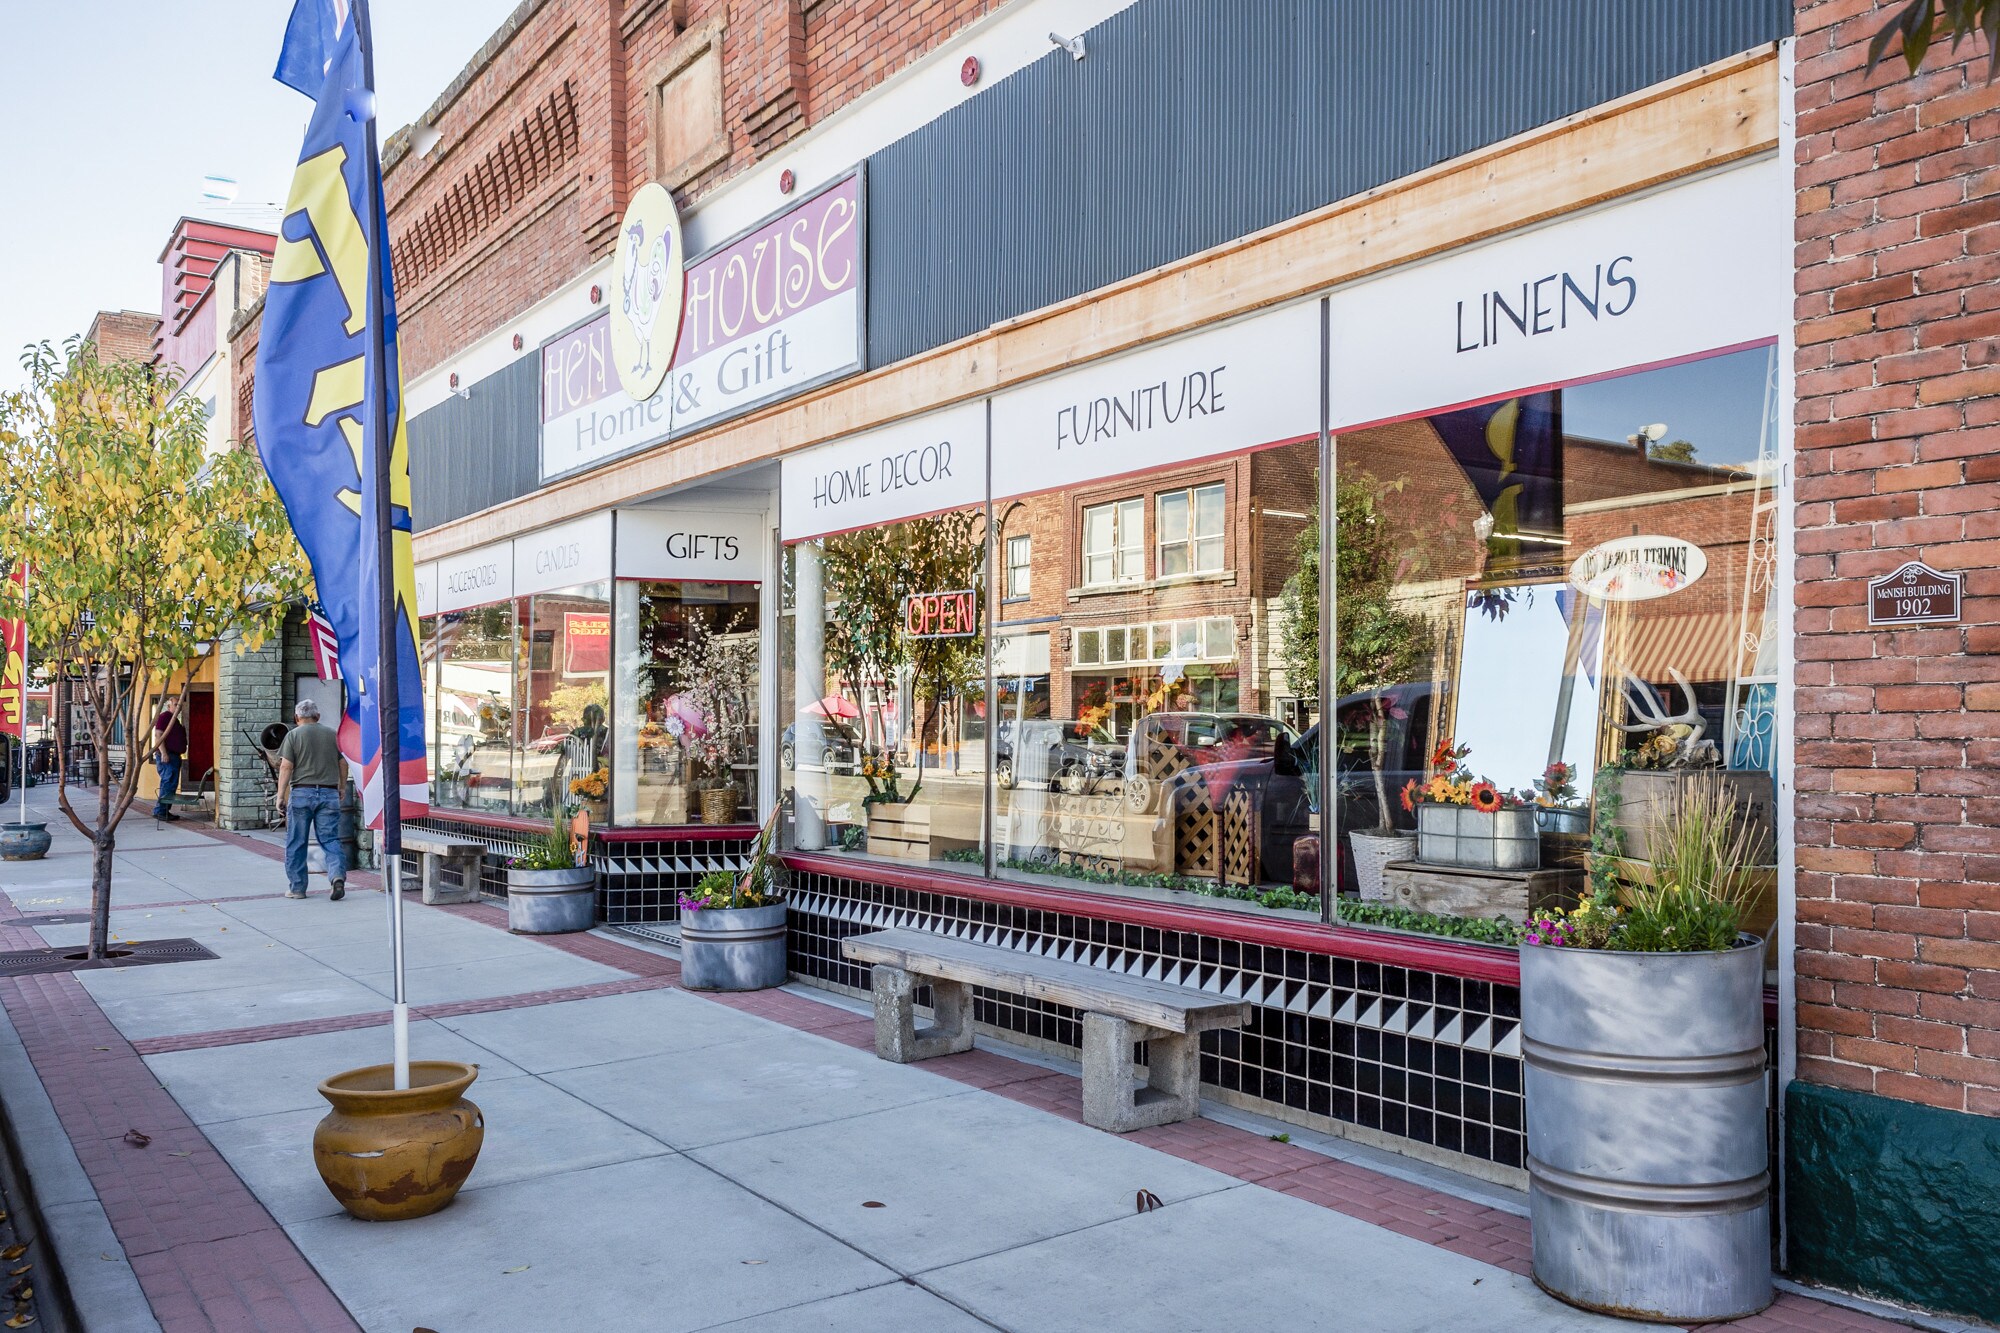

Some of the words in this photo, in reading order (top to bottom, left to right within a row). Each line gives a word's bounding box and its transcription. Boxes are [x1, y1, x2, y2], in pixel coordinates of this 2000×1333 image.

[545, 326, 607, 417] HEN
[687, 197, 856, 355] HOUSE
[1455, 256, 1638, 354] LINENS
[575, 394, 664, 452] Home
[675, 372, 702, 415] &
[717, 329, 793, 397] Gift
[1057, 365, 1227, 450] FURNITURE
[813, 464, 872, 509] HOME
[880, 441, 953, 494] DECOR
[535, 542, 580, 575] CANDLES
[666, 532, 740, 561] GIFTS
[447, 563, 497, 595] ACCESSORIES
[1907, 584, 1951, 597] BUILDING
[907, 590, 974, 636] OPEN
[1895, 597, 1932, 616] 1902
